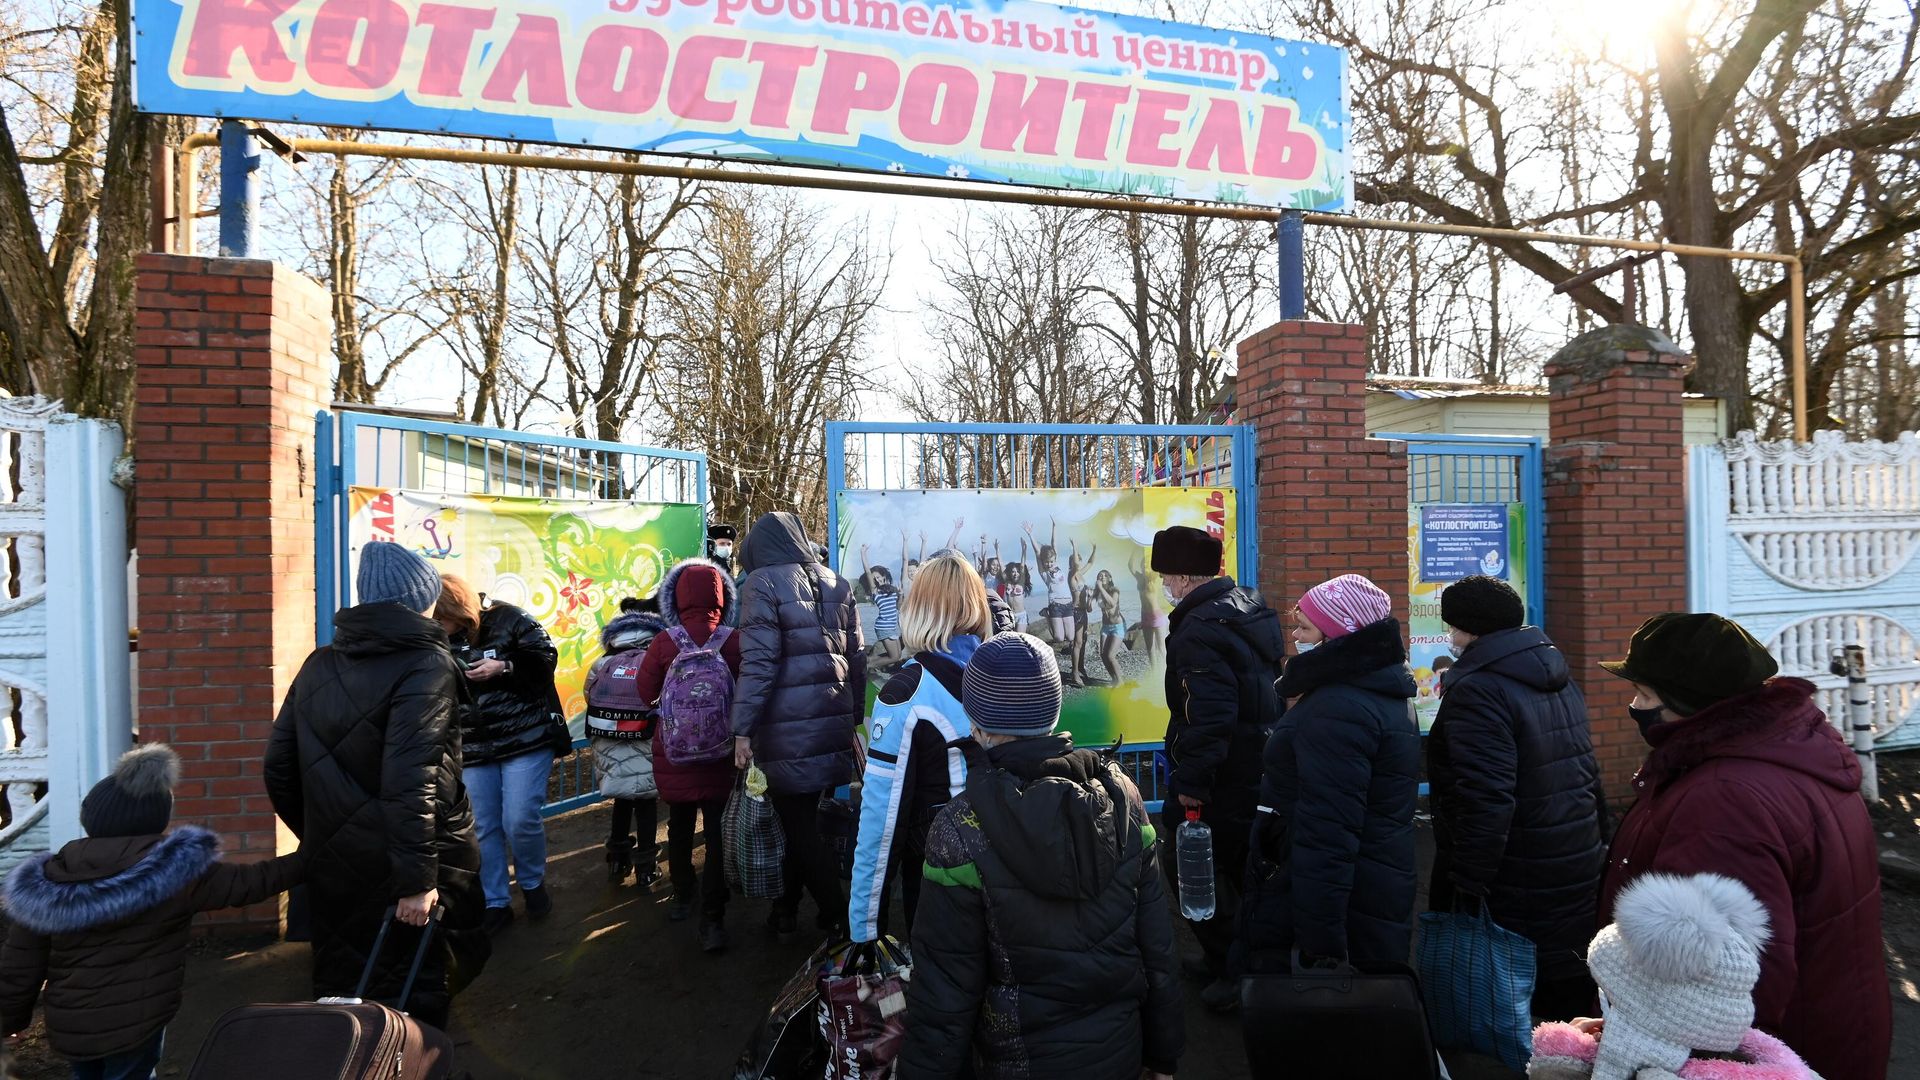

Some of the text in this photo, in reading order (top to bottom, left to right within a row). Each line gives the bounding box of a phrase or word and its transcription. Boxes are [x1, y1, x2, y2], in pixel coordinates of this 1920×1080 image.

[1112, 34, 1267, 90] центр
[181, 0, 1318, 182] КОТЛОСТРОИТЕЛЬ
[1425, 520, 1503, 530] «КОТЛОСТРОИТЕЛЬ»
[599, 710, 640, 720] TOMMY
[590, 728, 642, 739] HILFIGER
